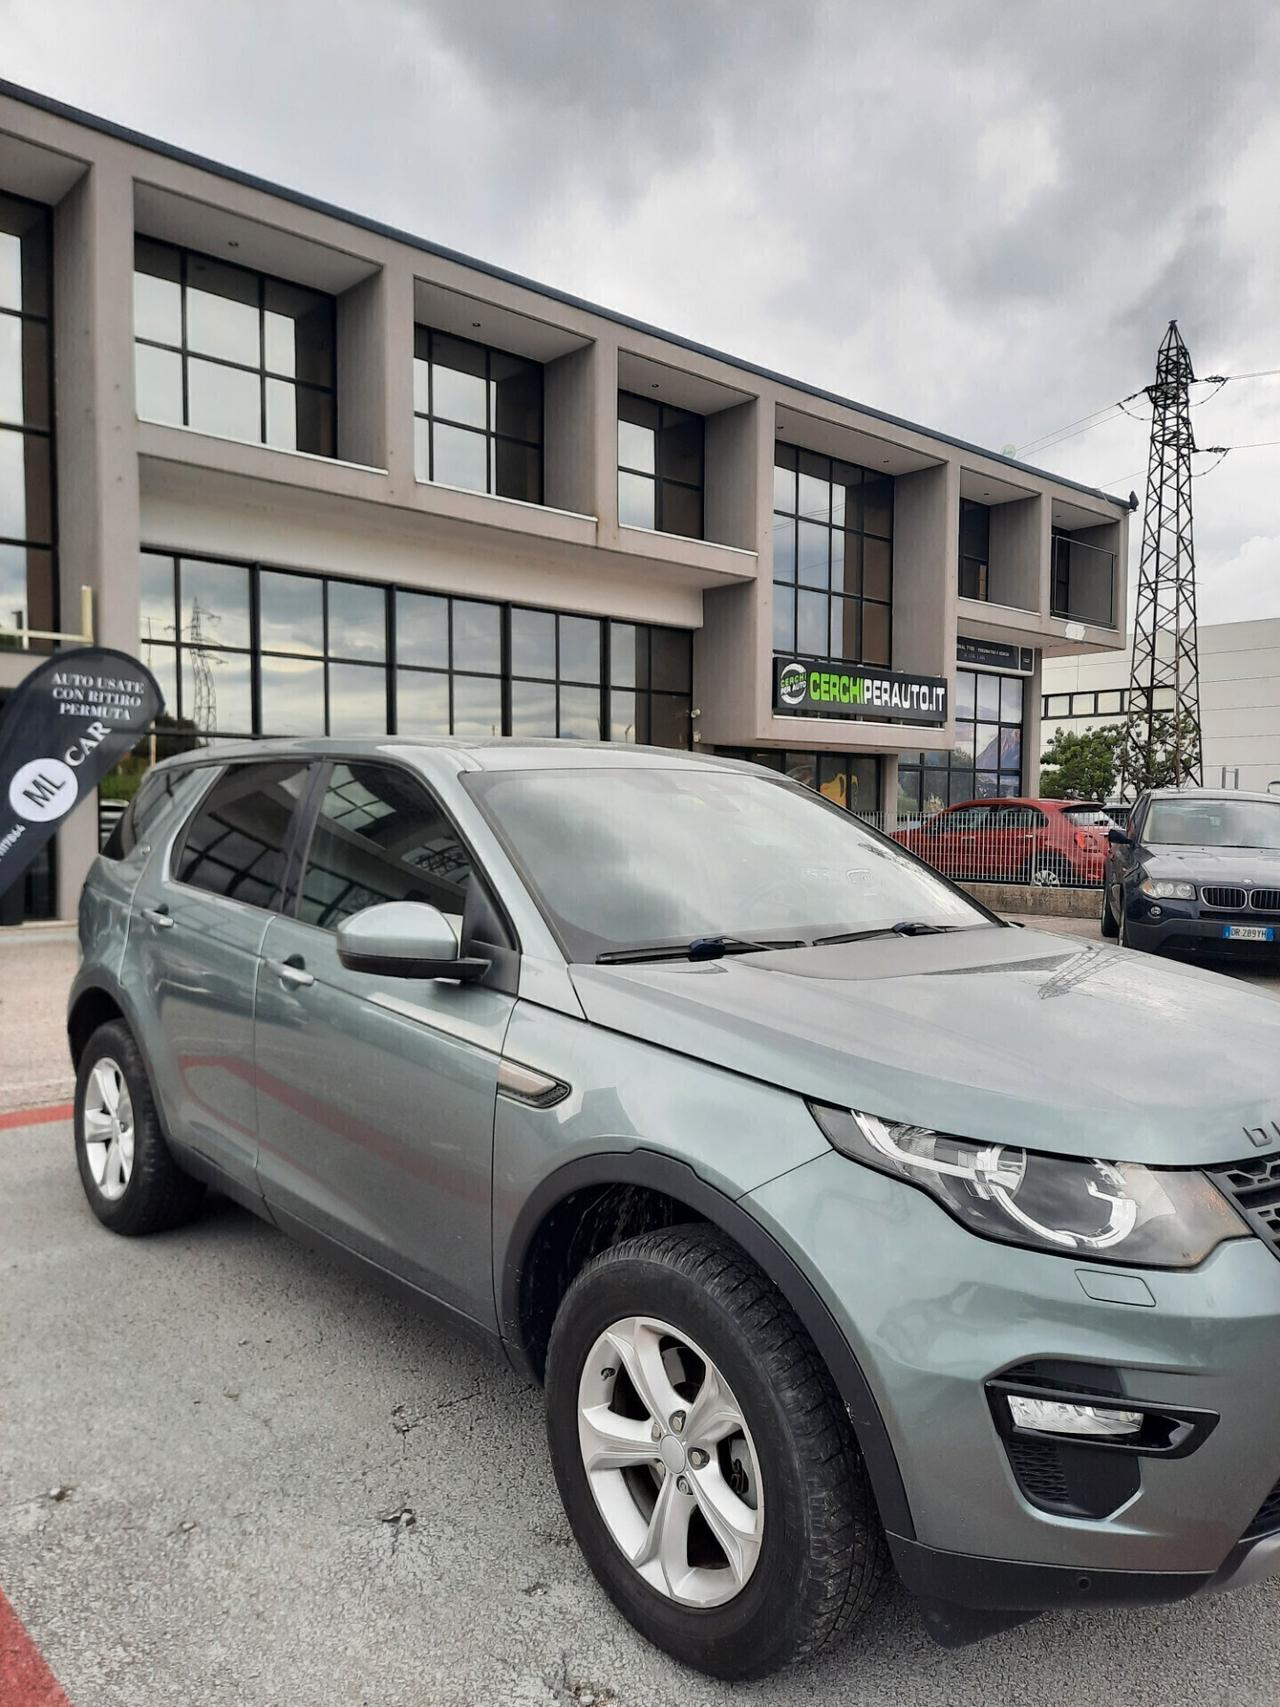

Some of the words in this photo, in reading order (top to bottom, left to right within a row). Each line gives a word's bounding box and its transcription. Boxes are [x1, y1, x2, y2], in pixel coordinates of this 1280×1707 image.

[52, 672, 94, 687] AUTO
[97, 677, 145, 694] USATE
[809, 671, 945, 712] CERCHIPERAUTO.IT
[52, 687, 84, 700] CON
[88, 690, 142, 707] RITIRO
[59, 702, 131, 720] PERMUTA
[22, 773, 66, 809] ML
[64, 721, 112, 767] CAR
